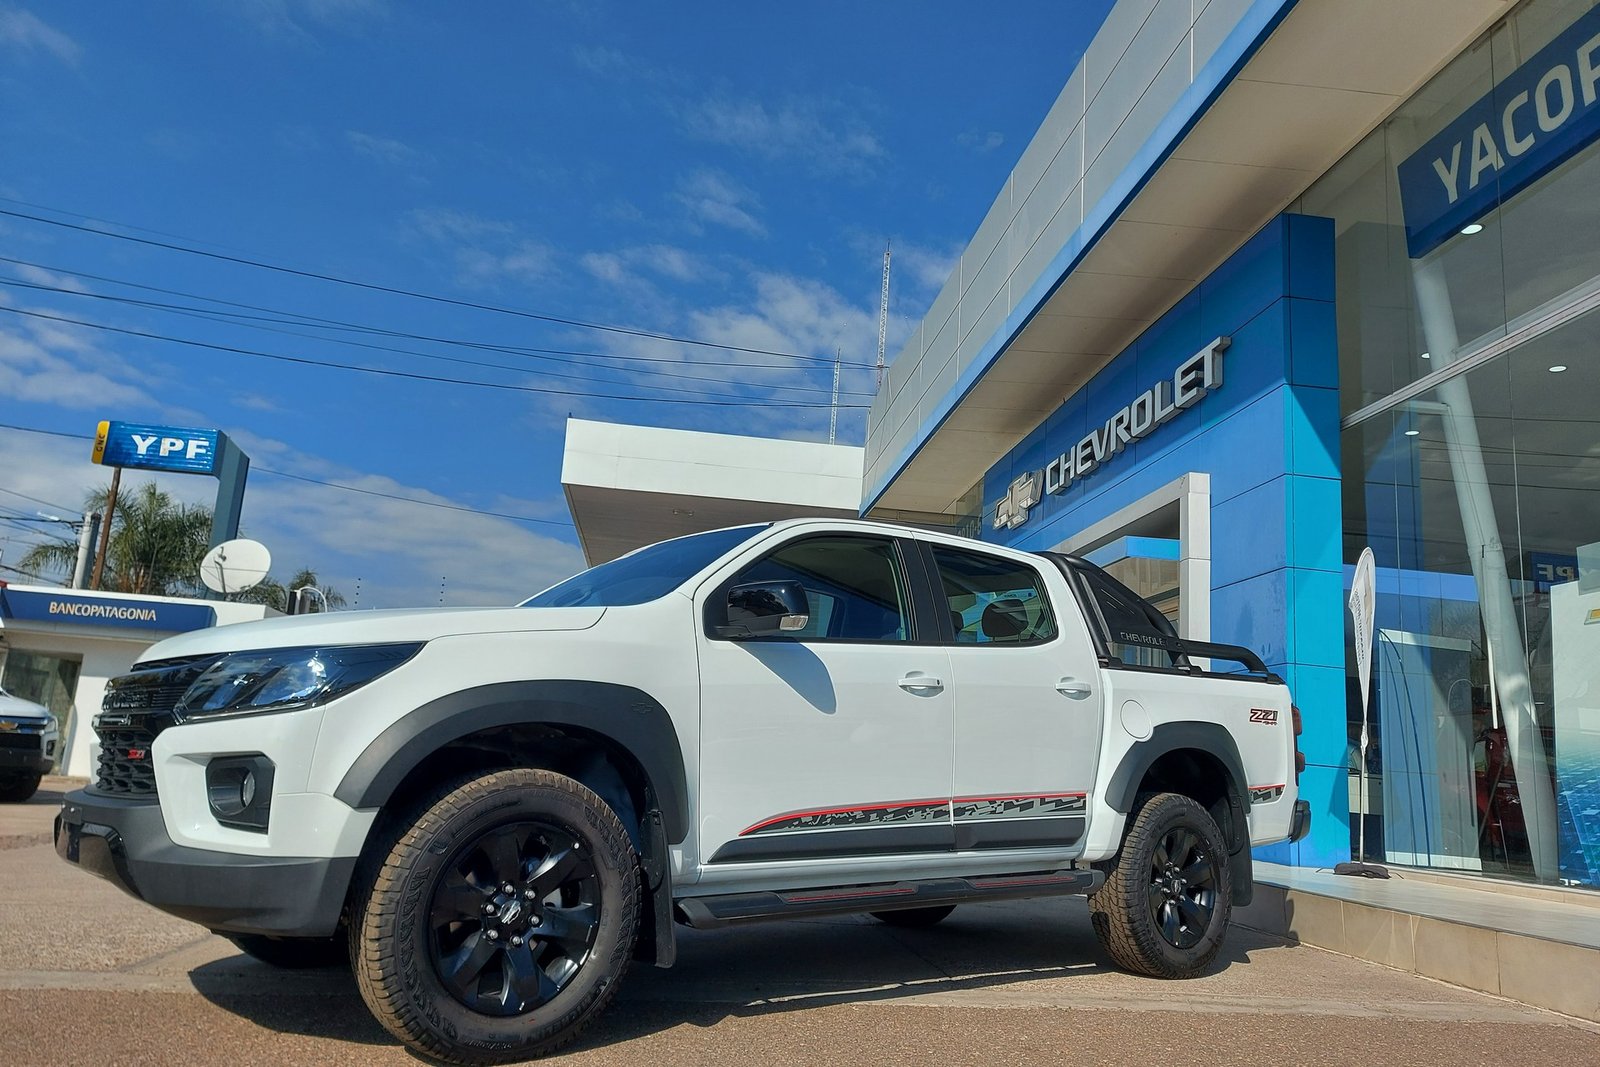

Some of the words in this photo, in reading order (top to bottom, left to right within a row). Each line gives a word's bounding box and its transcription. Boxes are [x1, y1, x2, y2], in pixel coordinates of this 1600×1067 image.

[1046, 336, 1231, 495] CHEVROLET
[131, 434, 209, 459] YPF
[49, 601, 156, 621] BANCOPATAGONIA
[1120, 631, 1169, 647] CHEVROLE
